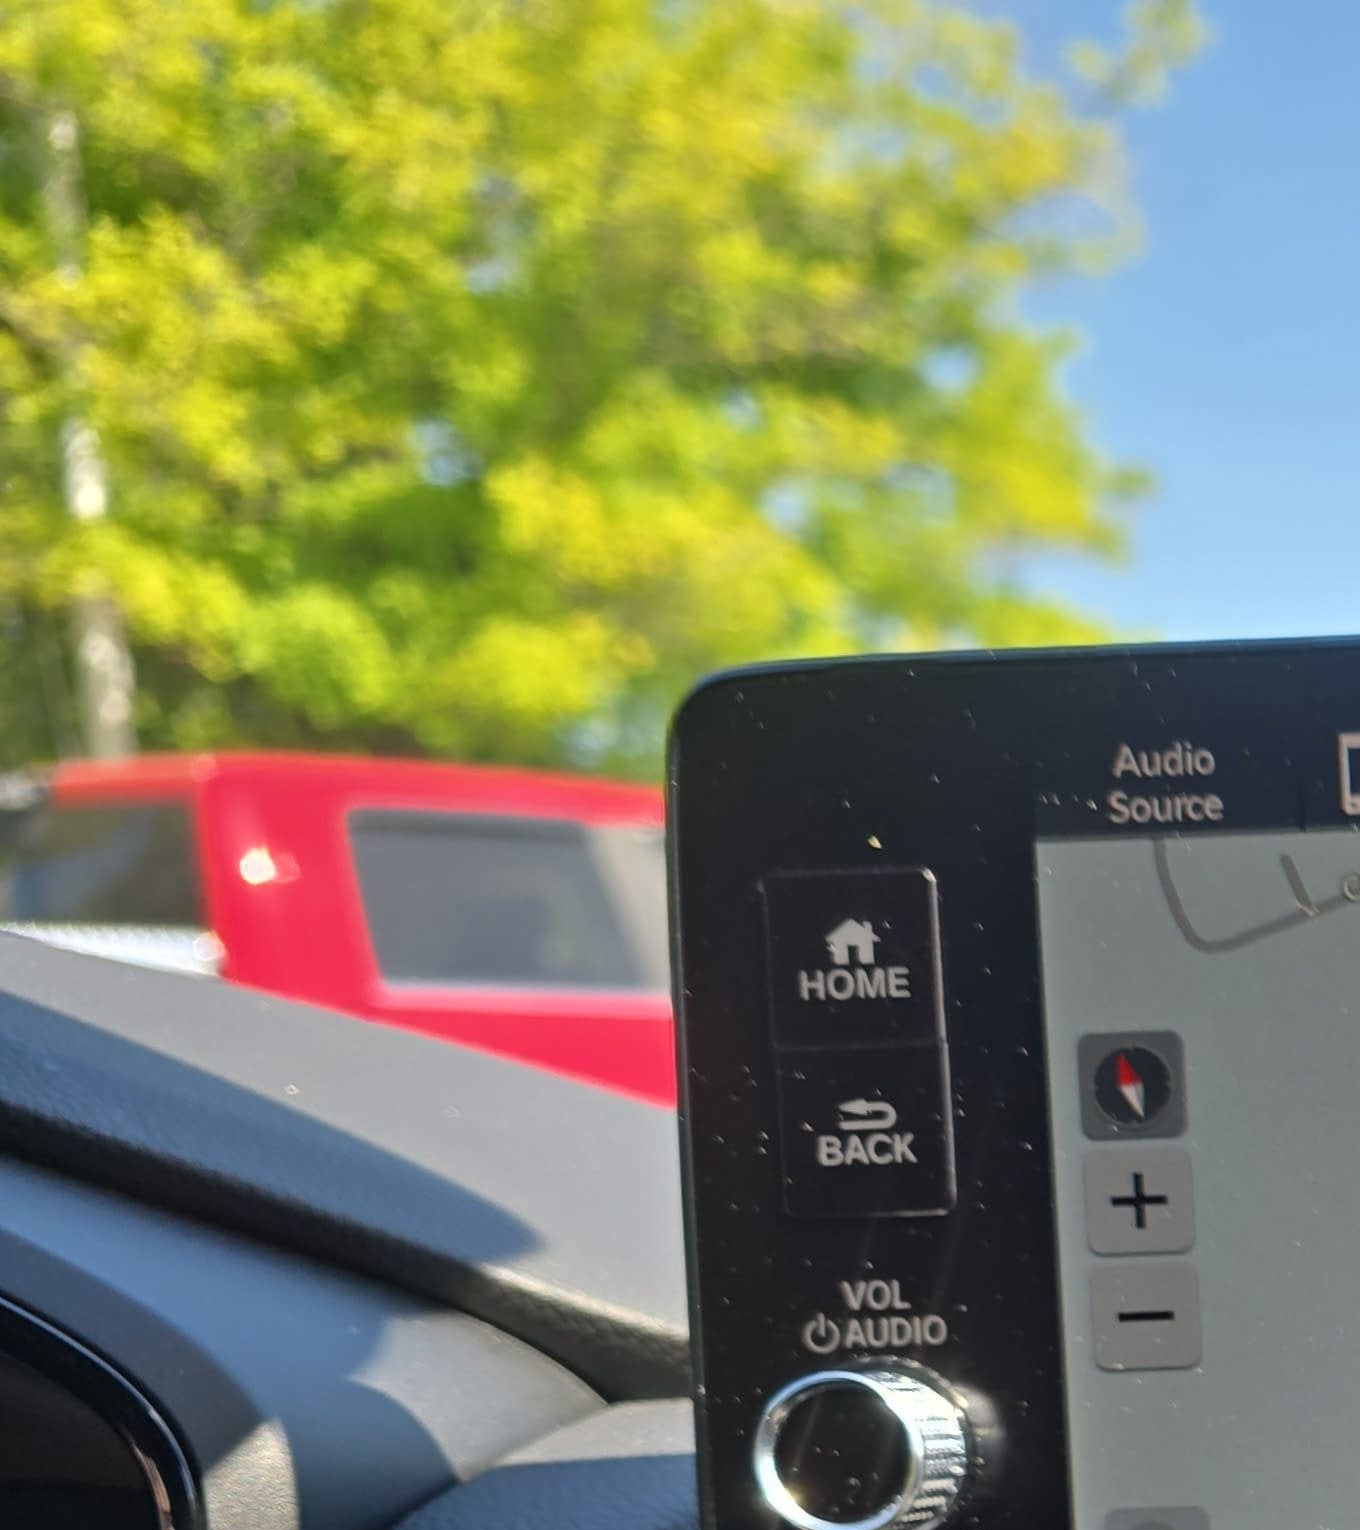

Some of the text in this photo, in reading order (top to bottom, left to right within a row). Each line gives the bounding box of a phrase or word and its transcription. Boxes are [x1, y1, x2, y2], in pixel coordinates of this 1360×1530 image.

[1113, 741, 1216, 778] Audio
[1107, 790, 1225, 824] Source
[799, 966, 911, 1001] HOME
[817, 1133, 918, 1167] BACK
[841, 1279, 911, 1311] VOL
[844, 1314, 947, 1348] AUDIO
